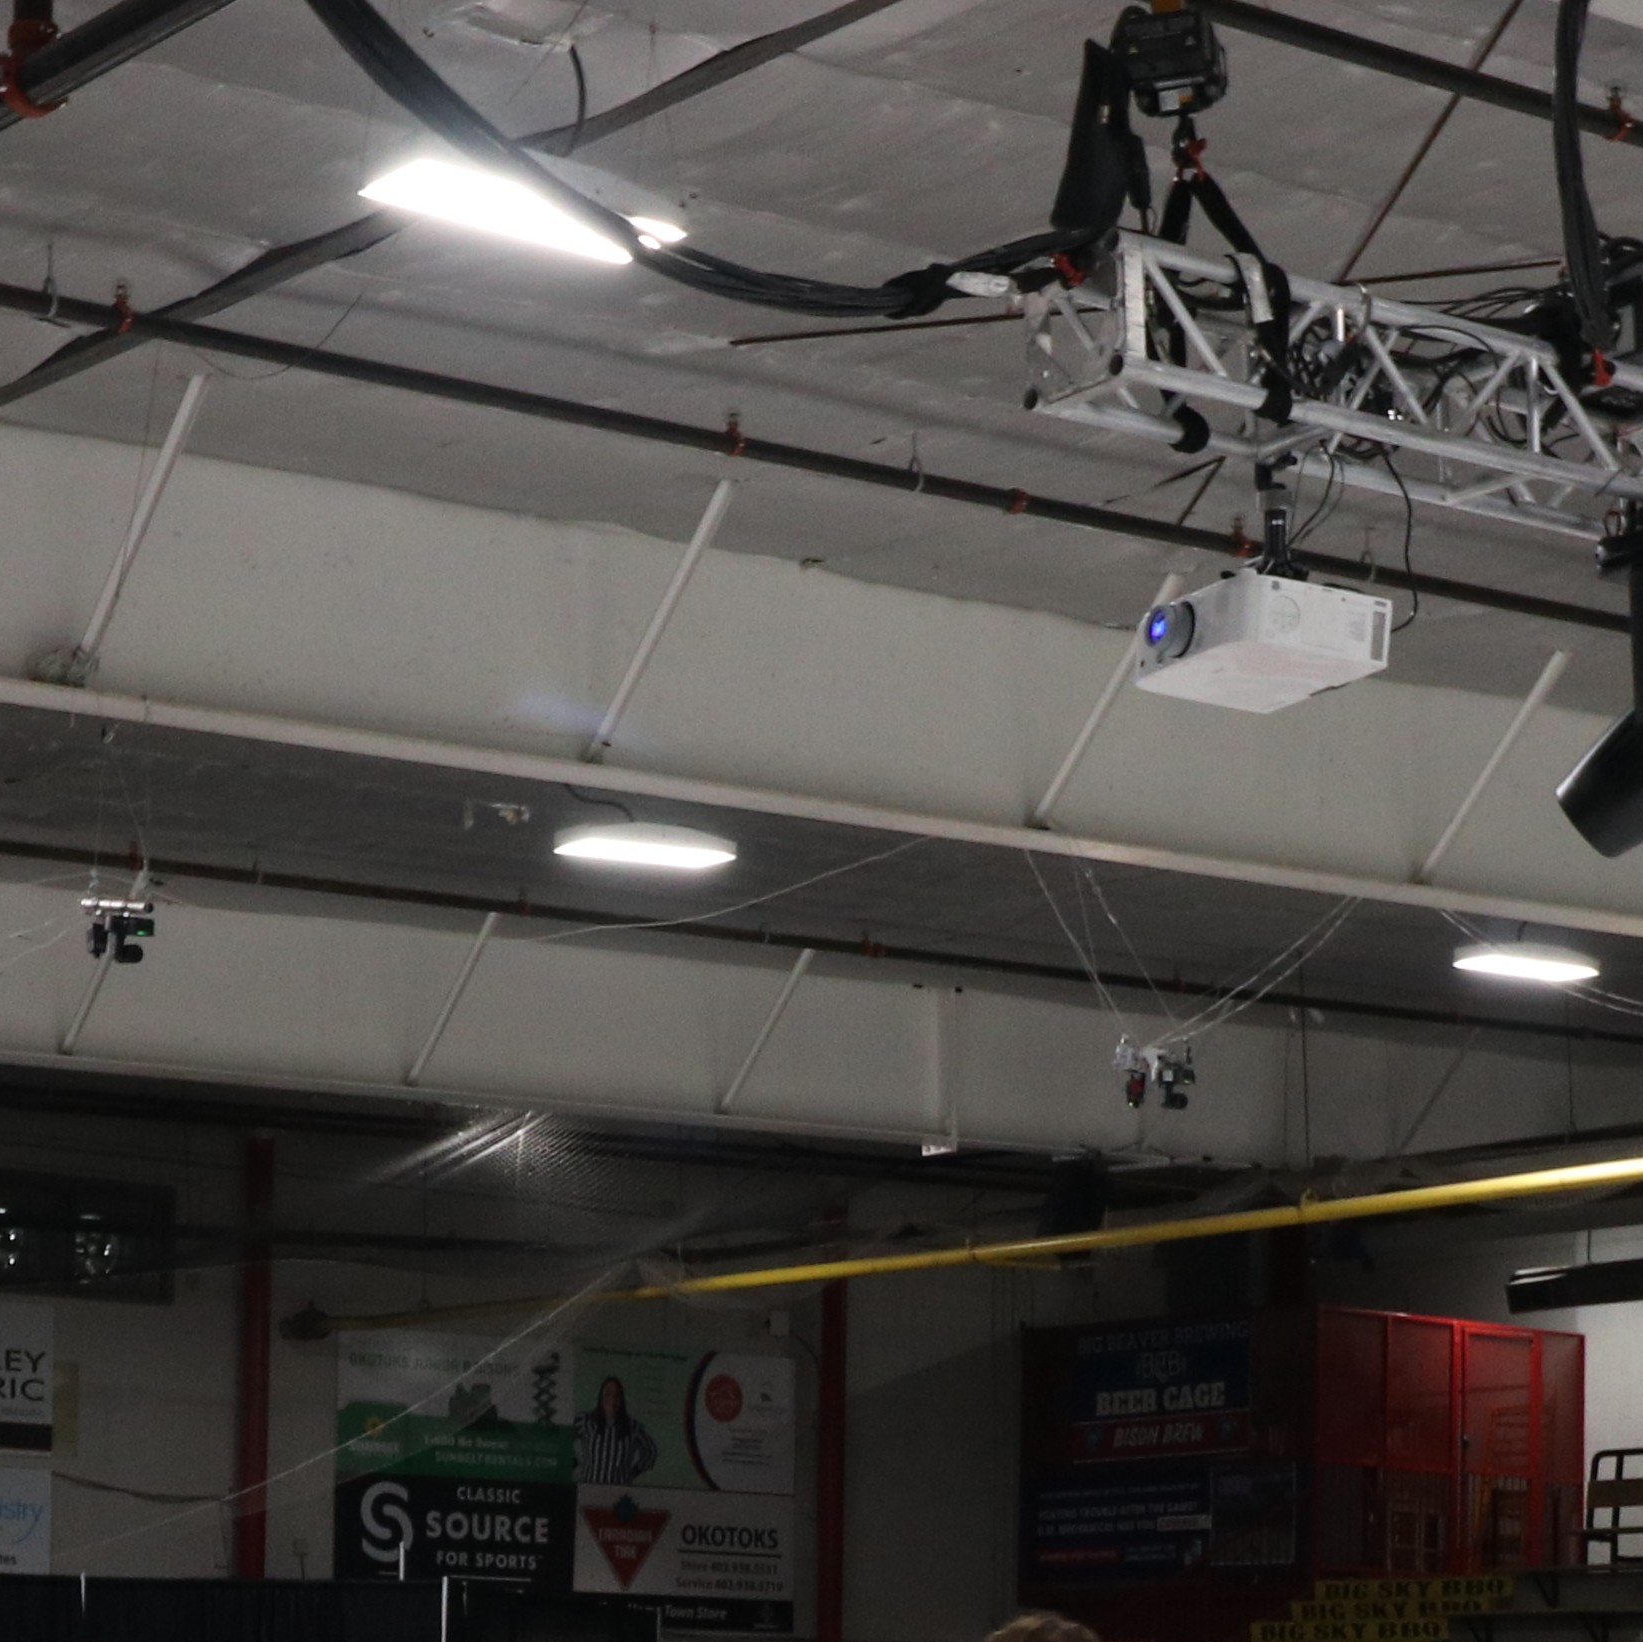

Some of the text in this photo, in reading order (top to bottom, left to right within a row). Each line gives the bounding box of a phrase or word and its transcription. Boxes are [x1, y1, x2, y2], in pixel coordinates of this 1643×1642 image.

[1108, 1329, 1170, 1353] BEAVER
[1175, 1320, 1250, 1345] BREWING
[1096, 1382, 1226, 1417] BEER CAGE
[1113, 1422, 1204, 1449] BISON BREW
[456, 1486, 522, 1505] CLASSIC
[425, 1510, 550, 1544] SOURCE
[681, 1523, 780, 1550] OKOTOKS
[436, 1550, 538, 1571] FOR SPORTS
[1324, 1577, 1506, 1601] BIG SKY BBQ
[1301, 1602, 1346, 1621] BIG
[1349, 1601, 1408, 1620] SKY
[1260, 1621, 1443, 1642] BIG SKY BBQ
